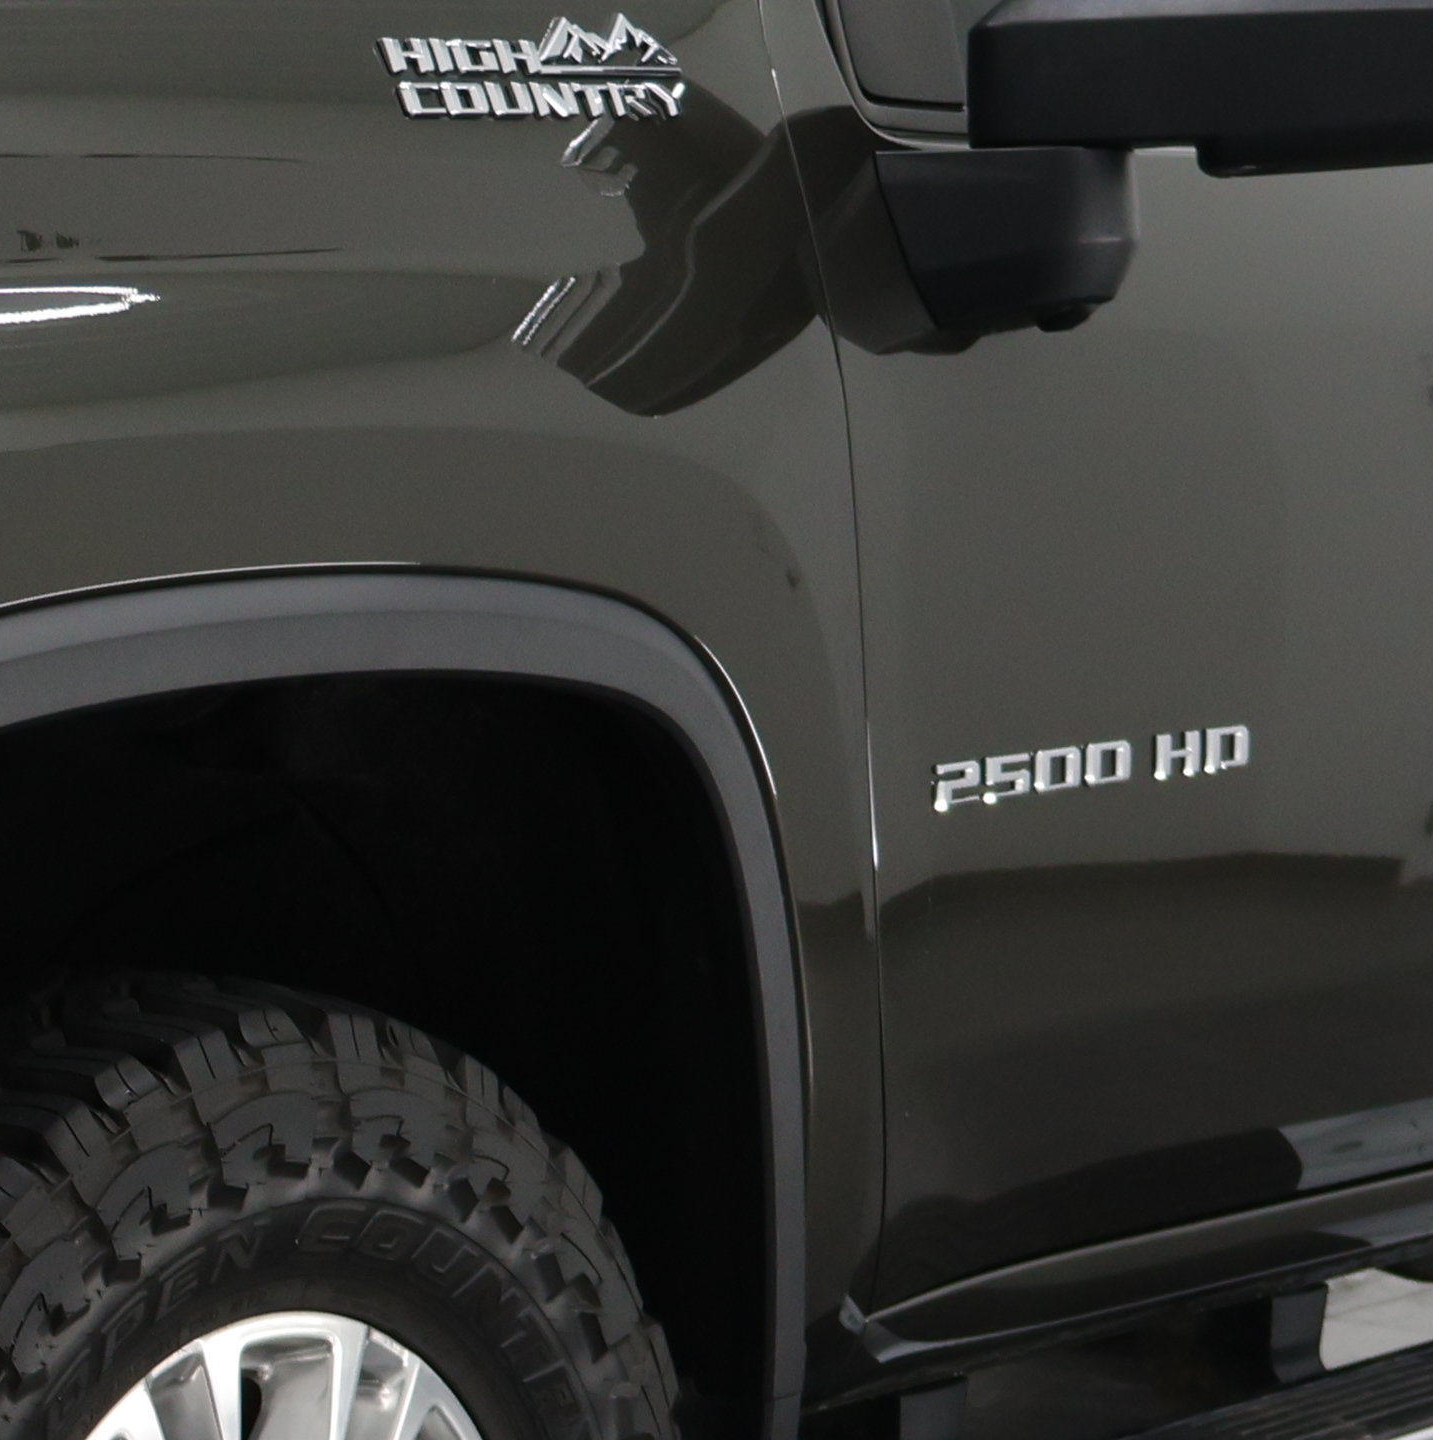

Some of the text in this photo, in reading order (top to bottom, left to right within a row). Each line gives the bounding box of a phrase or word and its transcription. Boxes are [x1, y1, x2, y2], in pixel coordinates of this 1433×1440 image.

[376, 36, 543, 76] HIGH
[394, 80, 686, 120] COUNTRY
[933, 723, 1250, 813] 2500 HD
